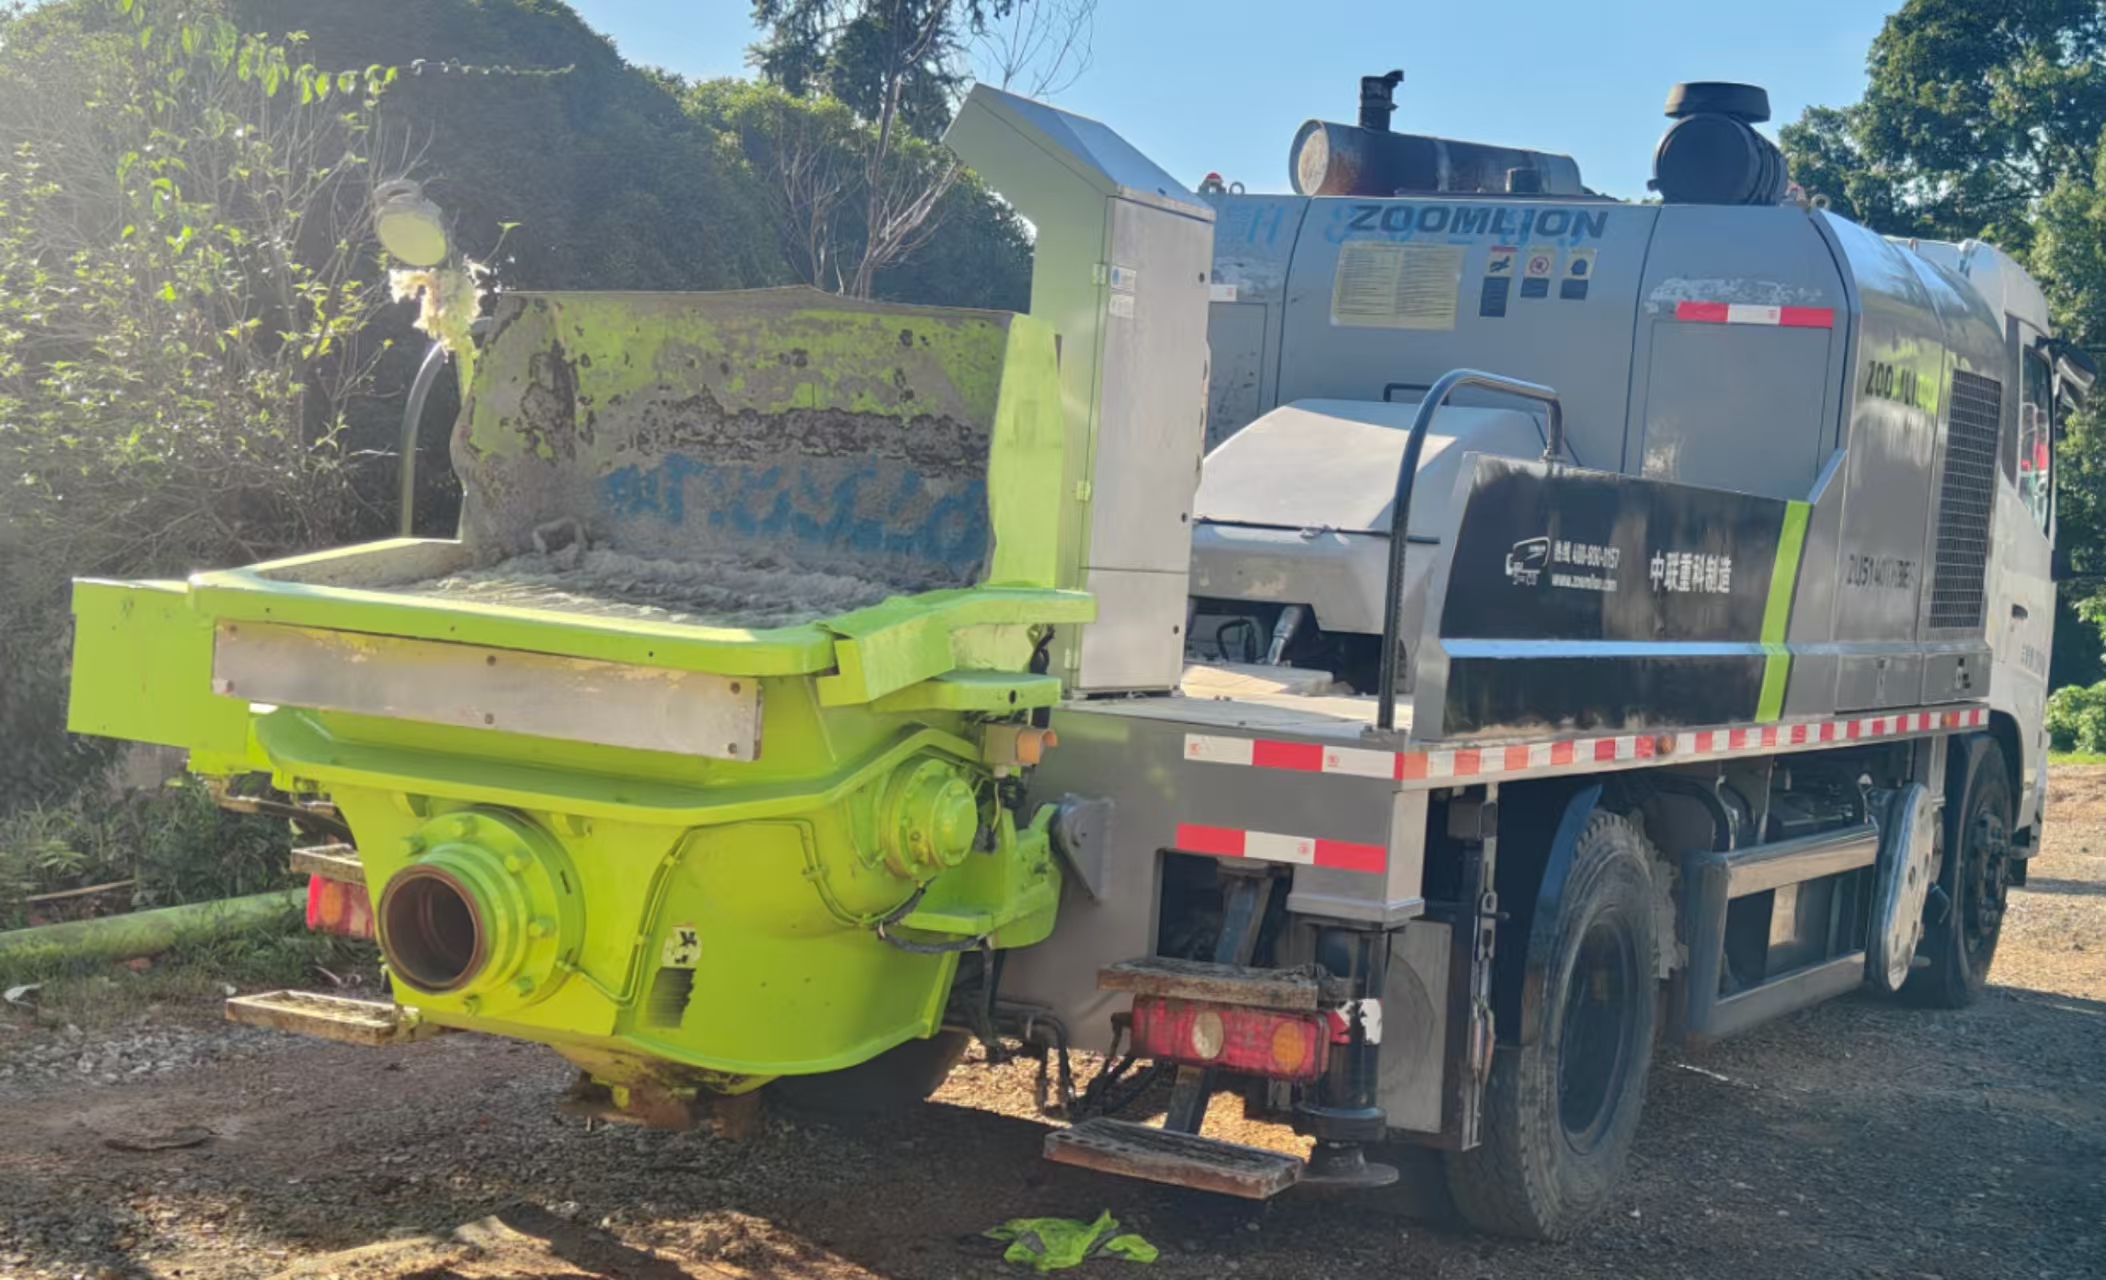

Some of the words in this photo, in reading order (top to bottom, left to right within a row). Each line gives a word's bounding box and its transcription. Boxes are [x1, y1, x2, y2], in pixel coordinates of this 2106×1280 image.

[1348, 204, 1609, 238] ZOOMLION
[1650, 549, 1732, 593] 中联重科制造
